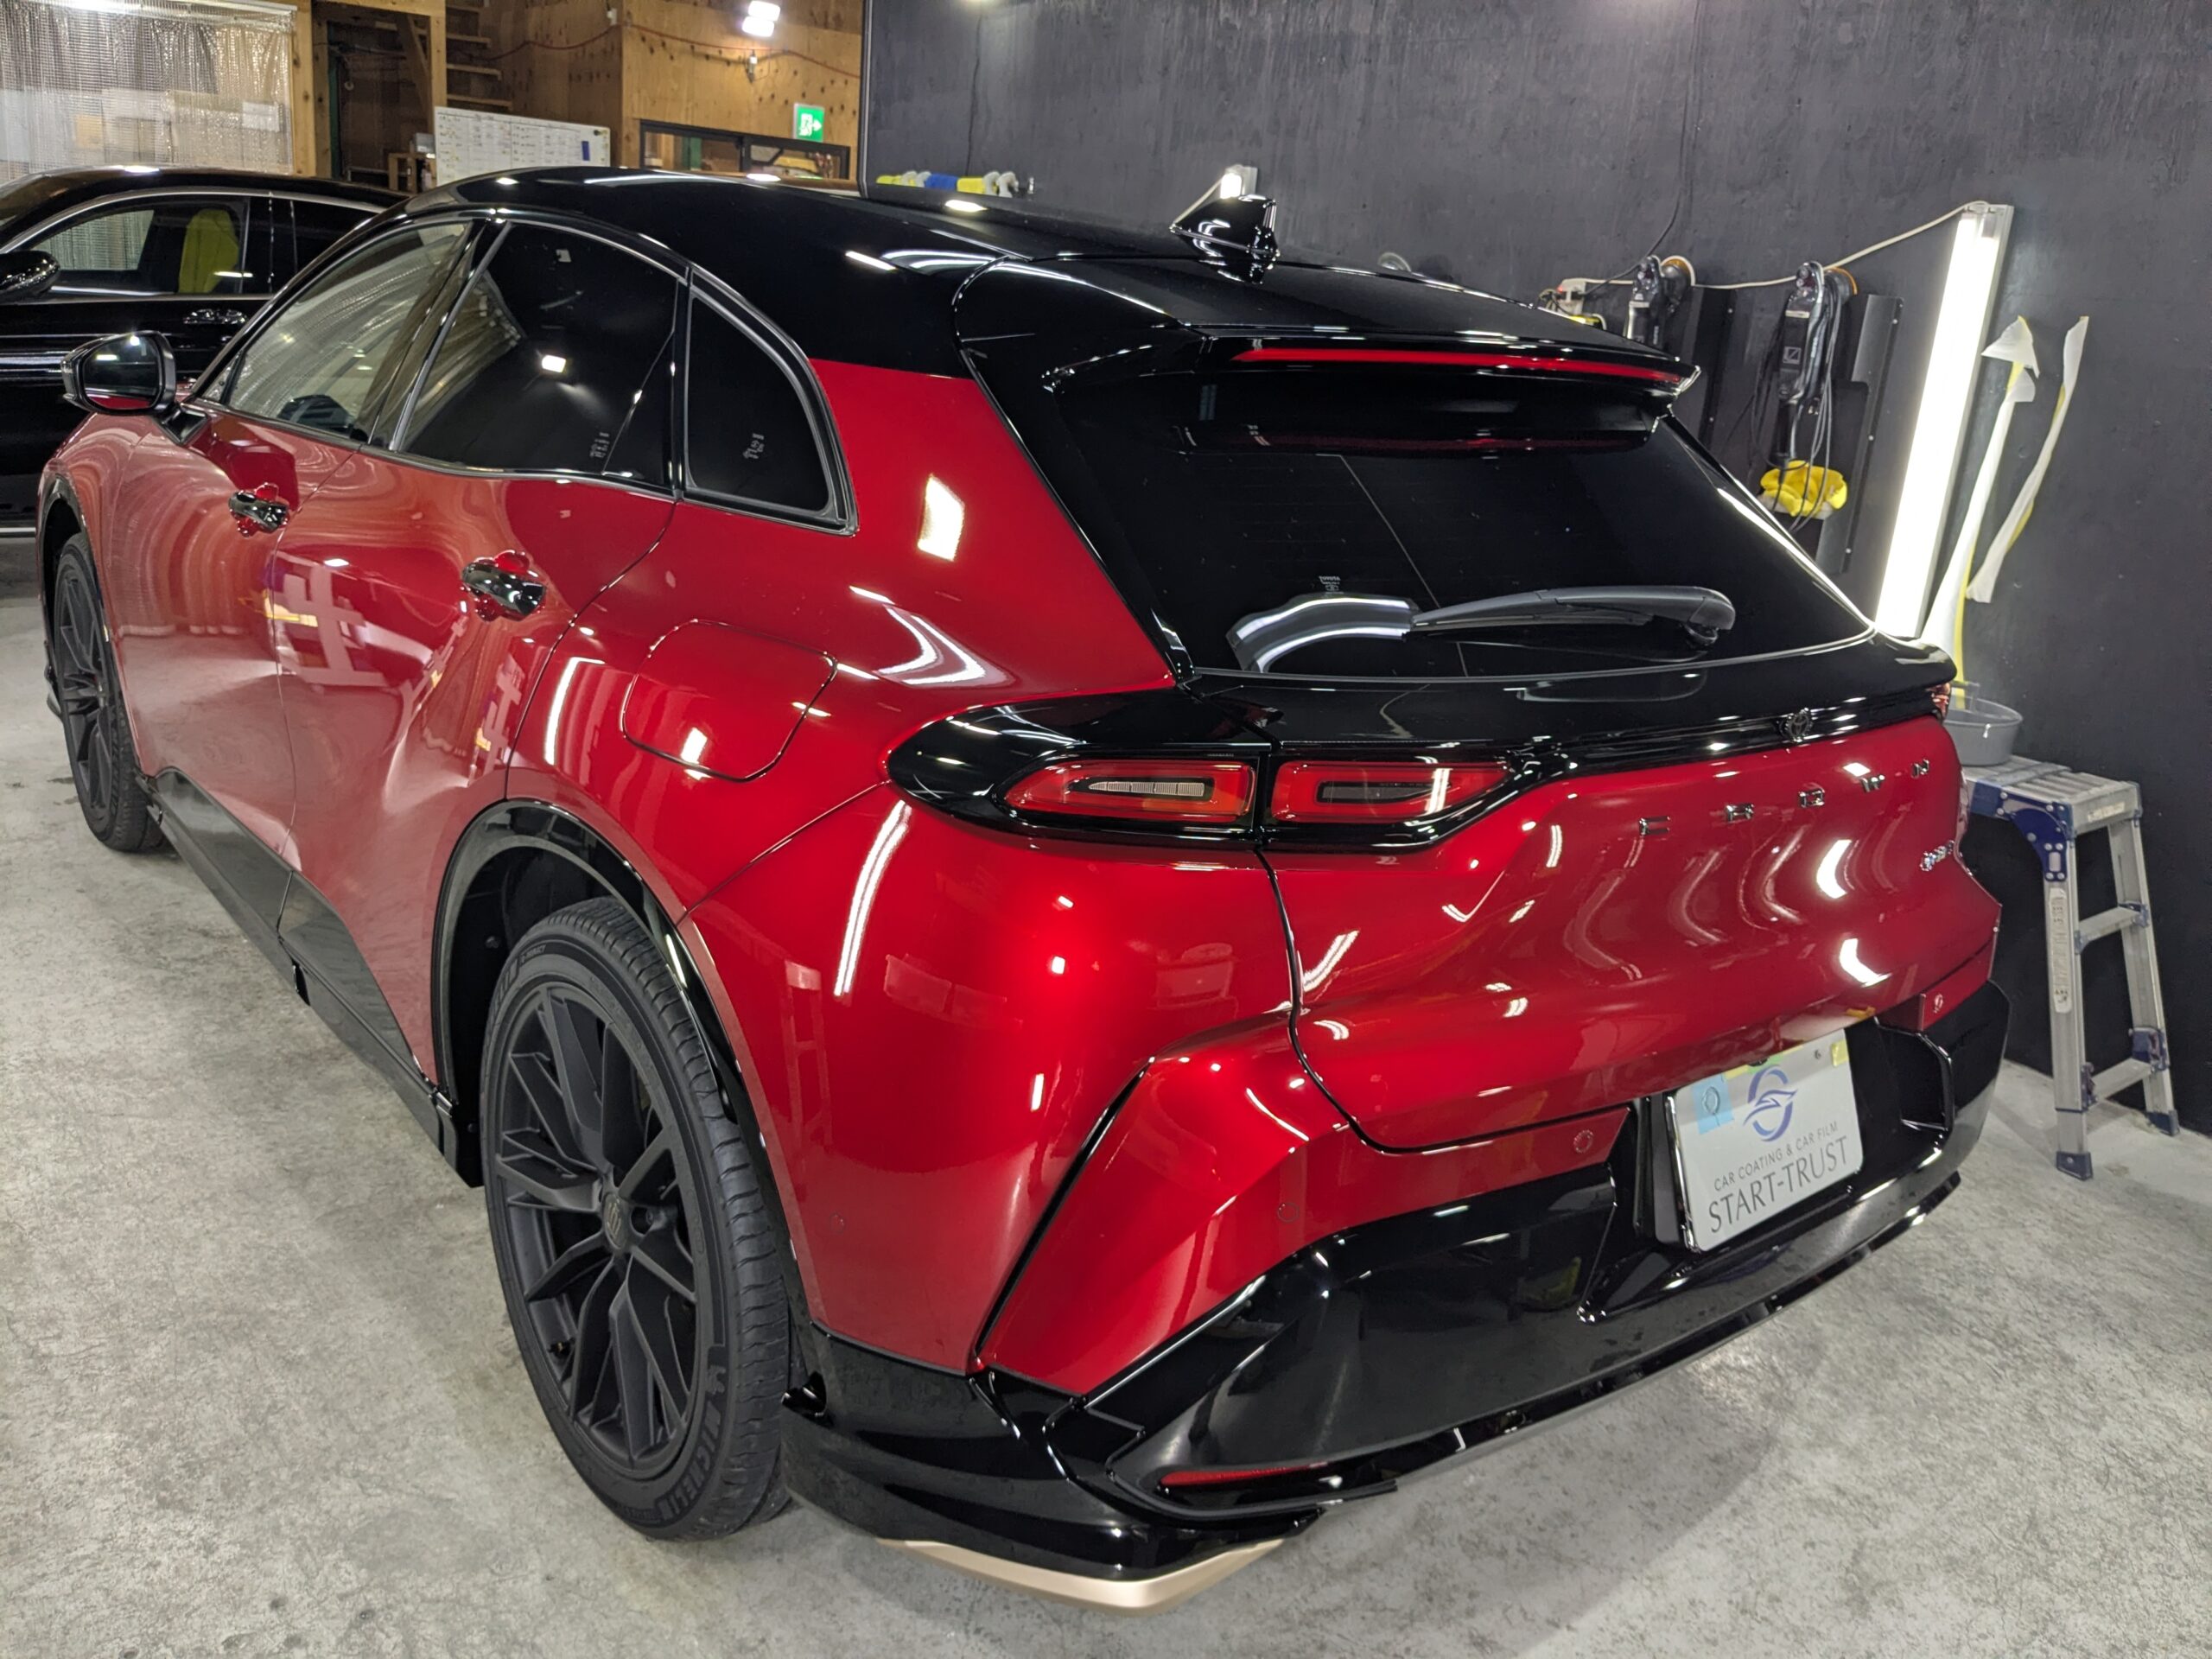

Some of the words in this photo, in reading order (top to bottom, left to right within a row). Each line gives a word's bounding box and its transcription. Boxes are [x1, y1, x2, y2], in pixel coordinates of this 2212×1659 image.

[1708, 1135, 1847, 1233] START-TRUST
[1713, 1172, 1735, 1192] CAR
[1738, 1148, 1783, 1179] COATING
[1786, 1143, 1794, 1156] &
[1796, 1133, 1815, 1150] CAR
[1817, 1121, 1839, 1141] FILM
[657, 1401, 721, 1521] MICHELIN
